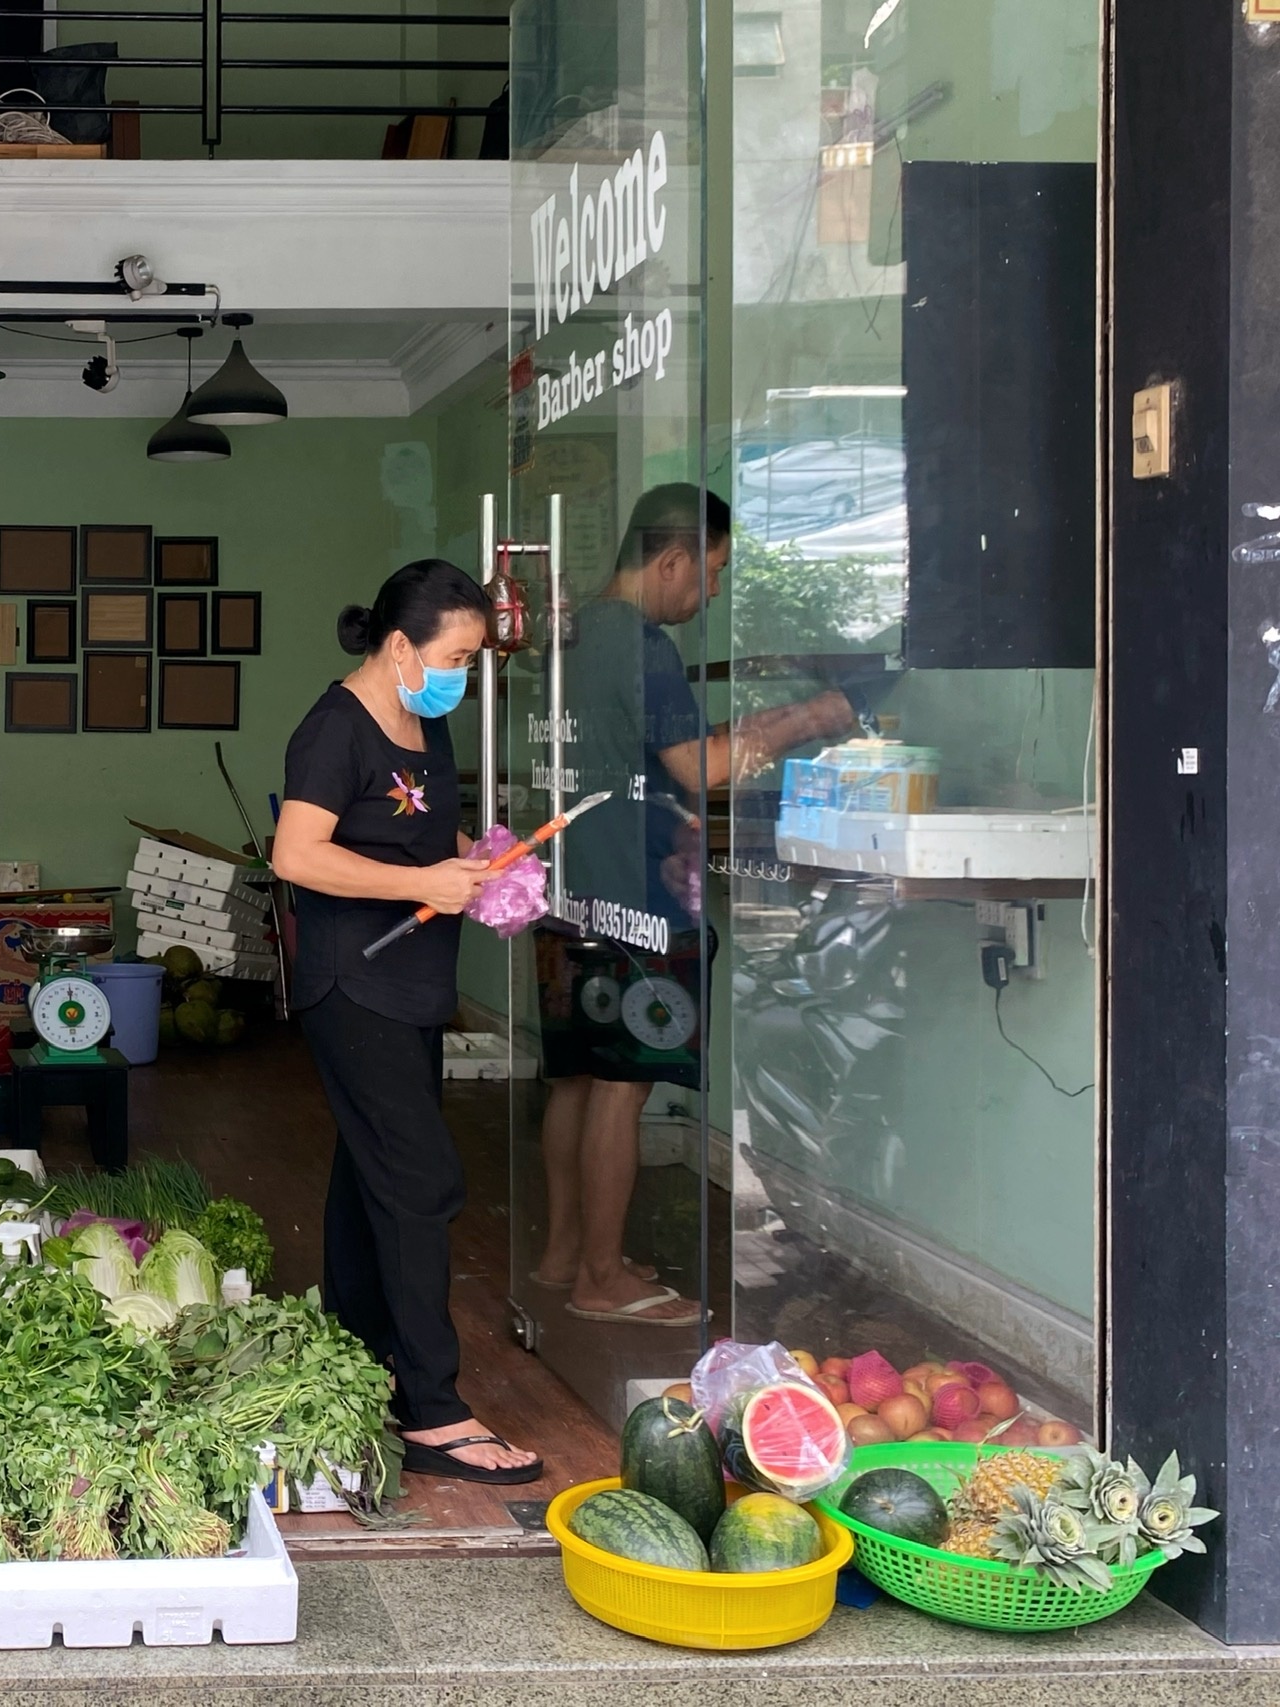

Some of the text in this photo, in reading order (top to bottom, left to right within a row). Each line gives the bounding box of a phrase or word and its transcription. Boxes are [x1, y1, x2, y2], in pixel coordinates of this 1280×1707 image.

[531, 130, 667, 341] Welcome
[537, 350, 605, 431] Barber
[613, 308, 672, 382] shop
[592, 898, 668, 955] 0935122900
